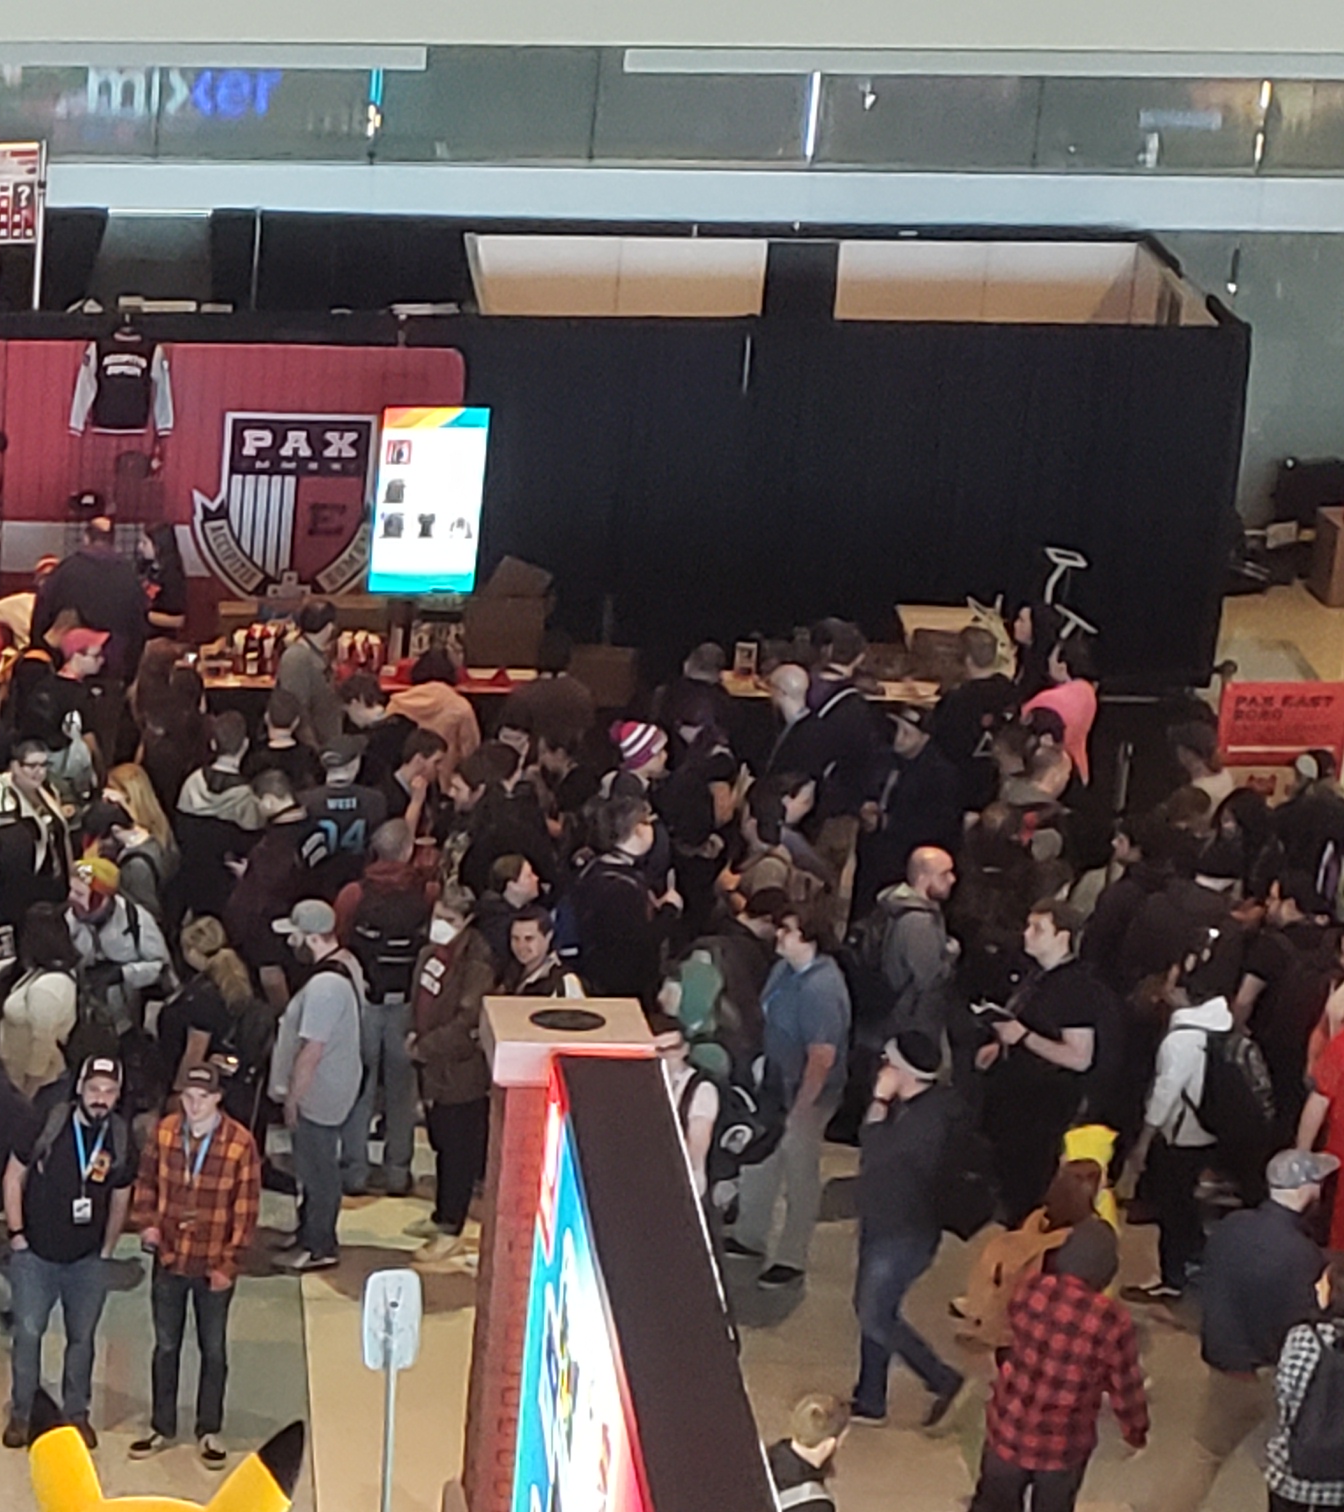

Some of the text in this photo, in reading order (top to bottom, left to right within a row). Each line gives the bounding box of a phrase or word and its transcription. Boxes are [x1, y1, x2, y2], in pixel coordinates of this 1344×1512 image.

[86, 67, 283, 118] mixer
[241, 428, 359, 458] PAX
[307, 502, 347, 537] E
[1235, 695, 1334, 708] PAX EAST
